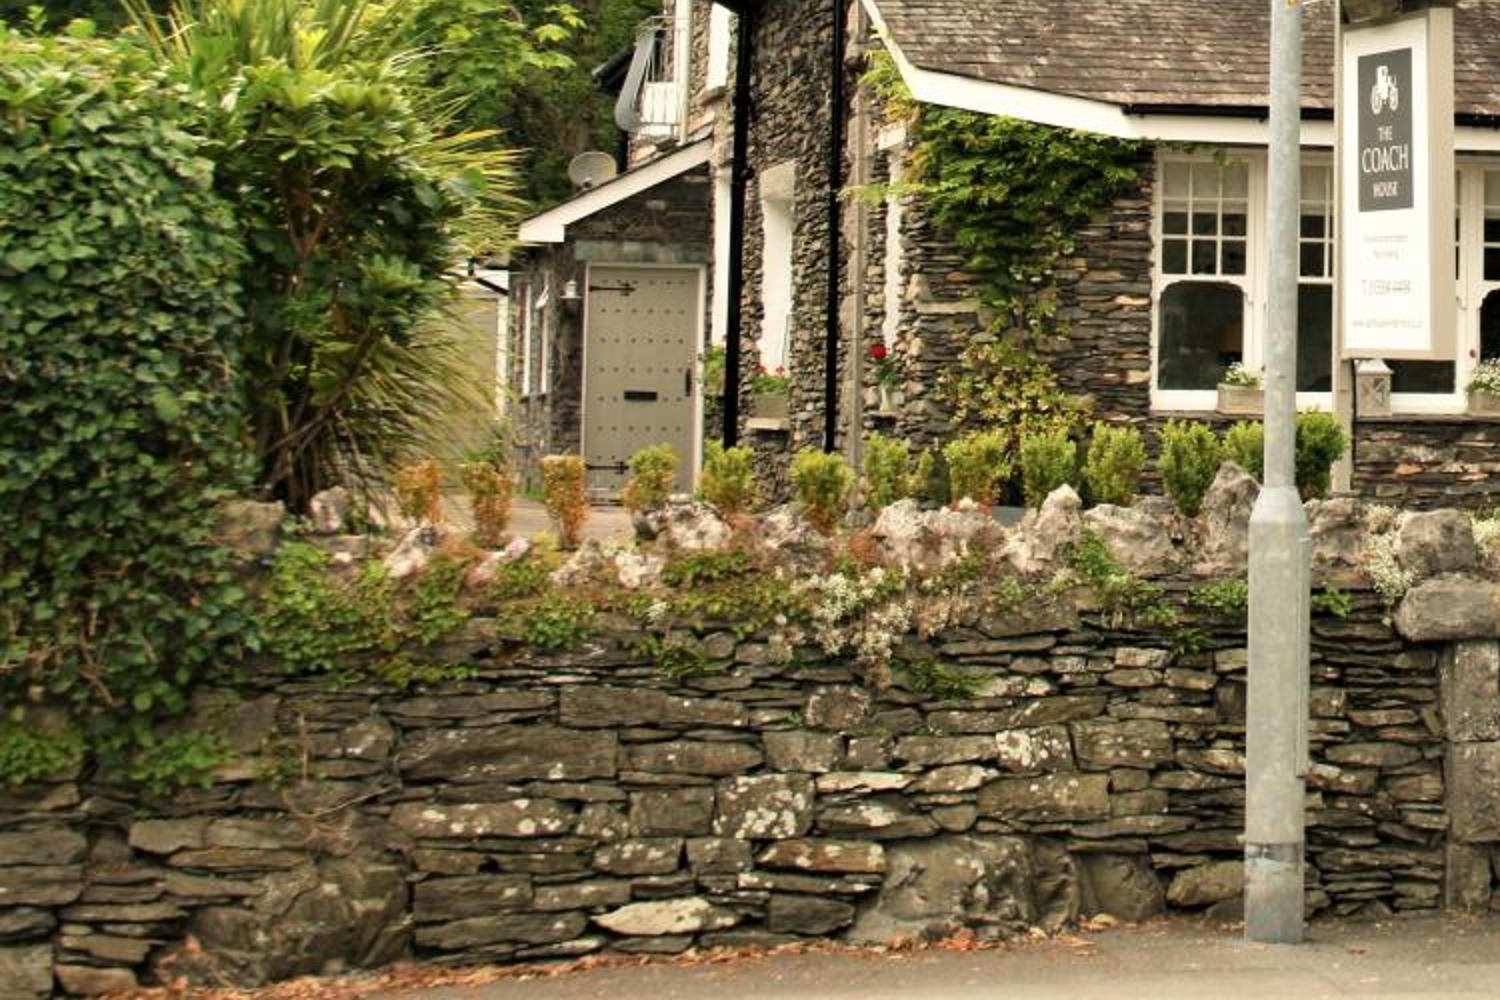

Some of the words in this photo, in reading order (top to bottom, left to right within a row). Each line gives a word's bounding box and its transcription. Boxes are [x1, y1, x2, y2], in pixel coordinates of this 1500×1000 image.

[1377, 125, 1393, 142] THE
[1361, 144, 1409, 173] COACH
[1372, 181, 1399, 198] HOUSE
